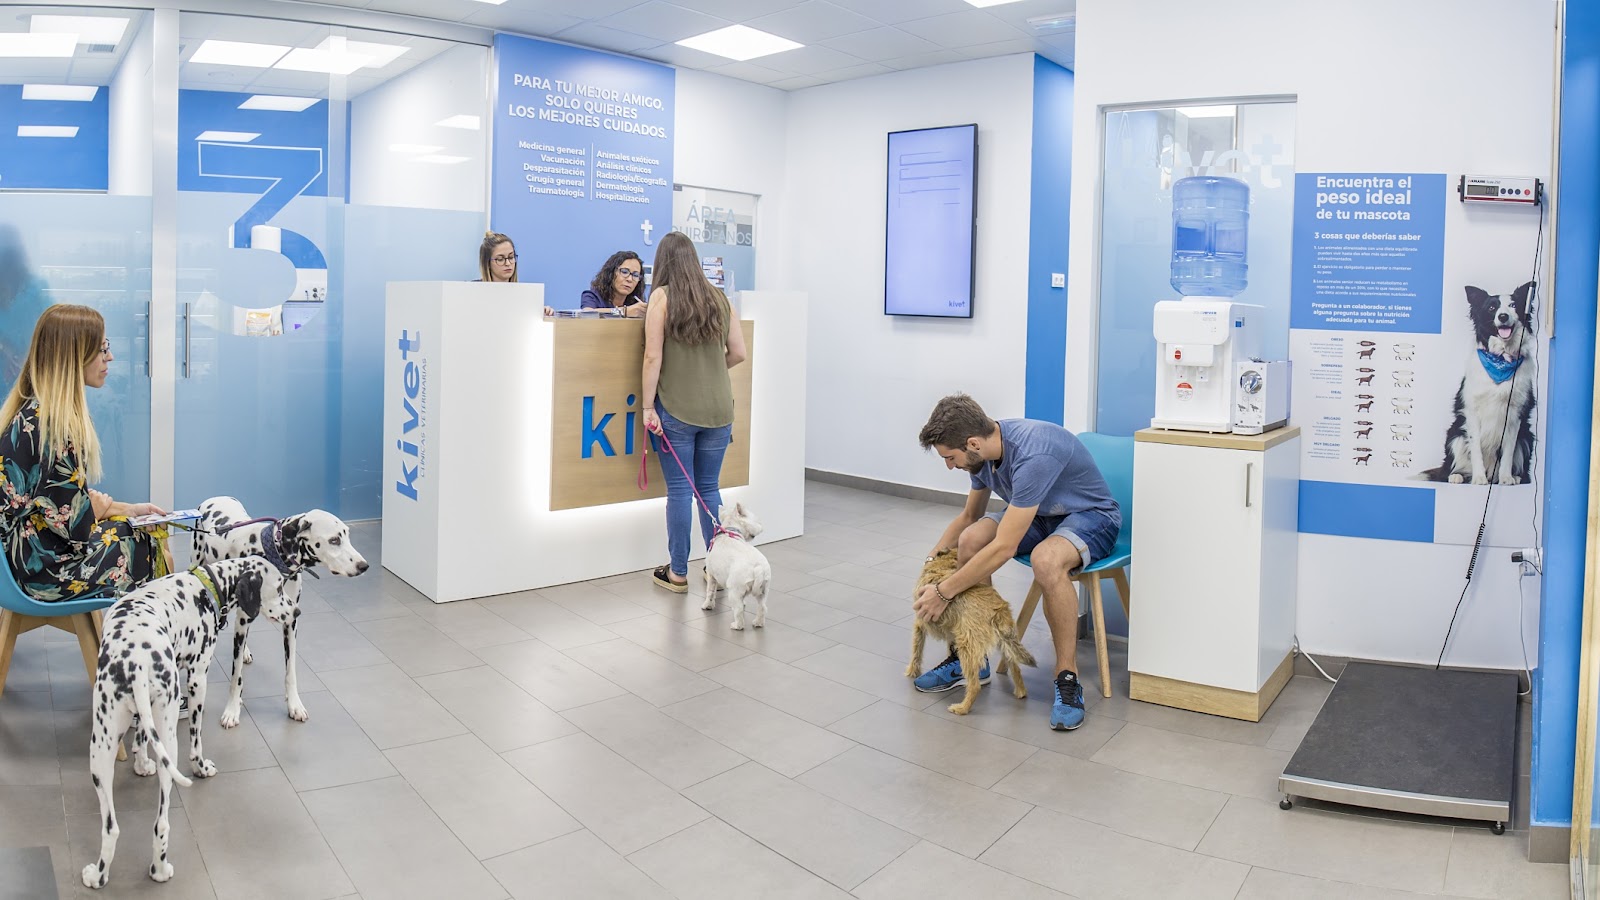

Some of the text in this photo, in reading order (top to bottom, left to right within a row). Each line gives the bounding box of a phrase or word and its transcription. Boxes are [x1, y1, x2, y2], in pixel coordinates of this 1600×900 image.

[514, 74, 664, 111] PARA TU MEJOR AMIGO,
[546, 94, 638, 119] SOLO QUIERES
[508, 104, 667, 138] LOS MEJORES CUIDADOS.
[519, 141, 585, 155] Medicina general
[541, 154, 585, 166] Vacunación
[596, 151, 659, 165] Animales exóticos
[524, 163, 585, 176] Desparasitación
[596, 161, 651, 174] Análisis clínicos
[526, 174, 584, 186] Cirugía general
[1316, 176, 1412, 189] Encuentra el
[528, 185, 584, 198] Traumatología
[596, 181, 644, 193] Dermatología
[596, 192, 650, 204] Hospitalización
[1316, 189, 1411, 207] peso ideal
[687, 200, 738, 225] ÁREA
[1316, 209, 1410, 220] de tu mascota
[198, 141, 328, 337] 3
[396, 330, 421, 501] kivet
